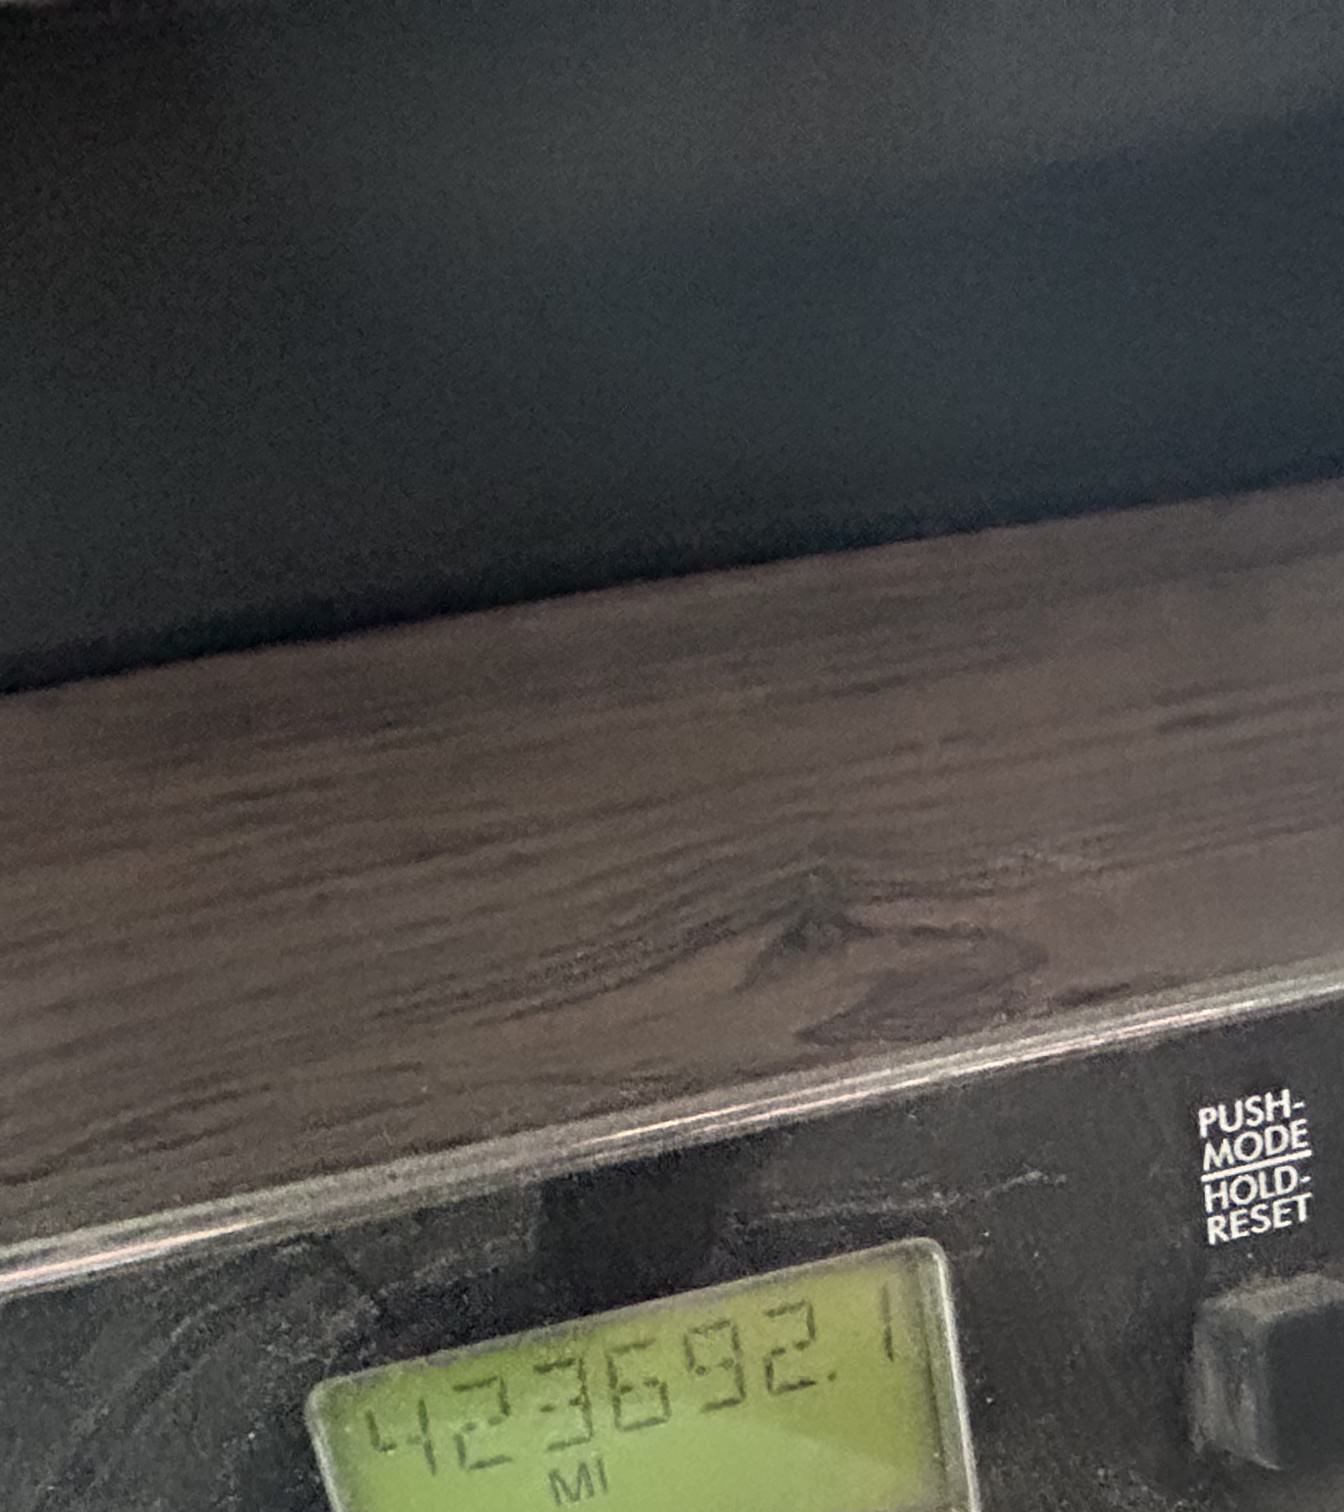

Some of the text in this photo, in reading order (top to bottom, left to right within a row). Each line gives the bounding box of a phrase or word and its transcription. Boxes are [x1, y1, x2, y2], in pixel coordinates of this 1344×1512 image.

[1198, 1088, 1305, 1138] PUSH-
[1203, 1119, 1309, 1171] MODE
[1203, 1165, 1311, 1213] HOLD-
[1207, 1192, 1313, 1245] RESET
[546, 1456, 611, 1507] MI
